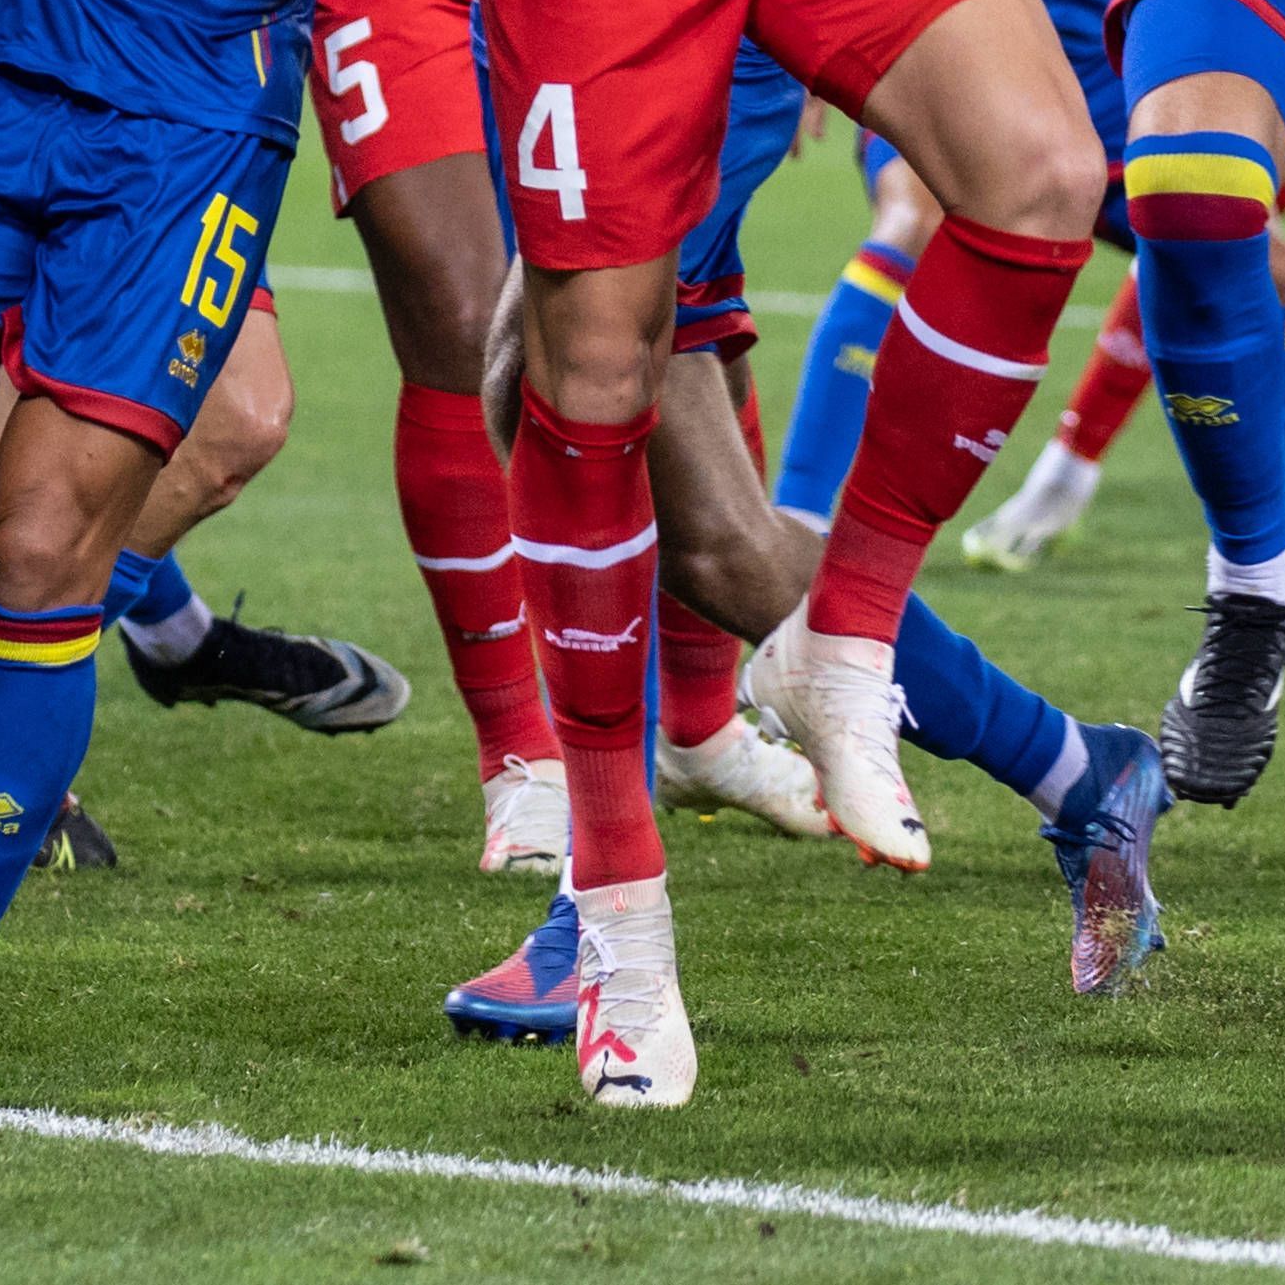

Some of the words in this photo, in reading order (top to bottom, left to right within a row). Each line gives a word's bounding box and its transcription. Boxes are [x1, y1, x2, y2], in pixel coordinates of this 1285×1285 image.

[323, 16, 389, 146] 5
[517, 83, 588, 221] 4
[180, 191, 260, 329] 15
